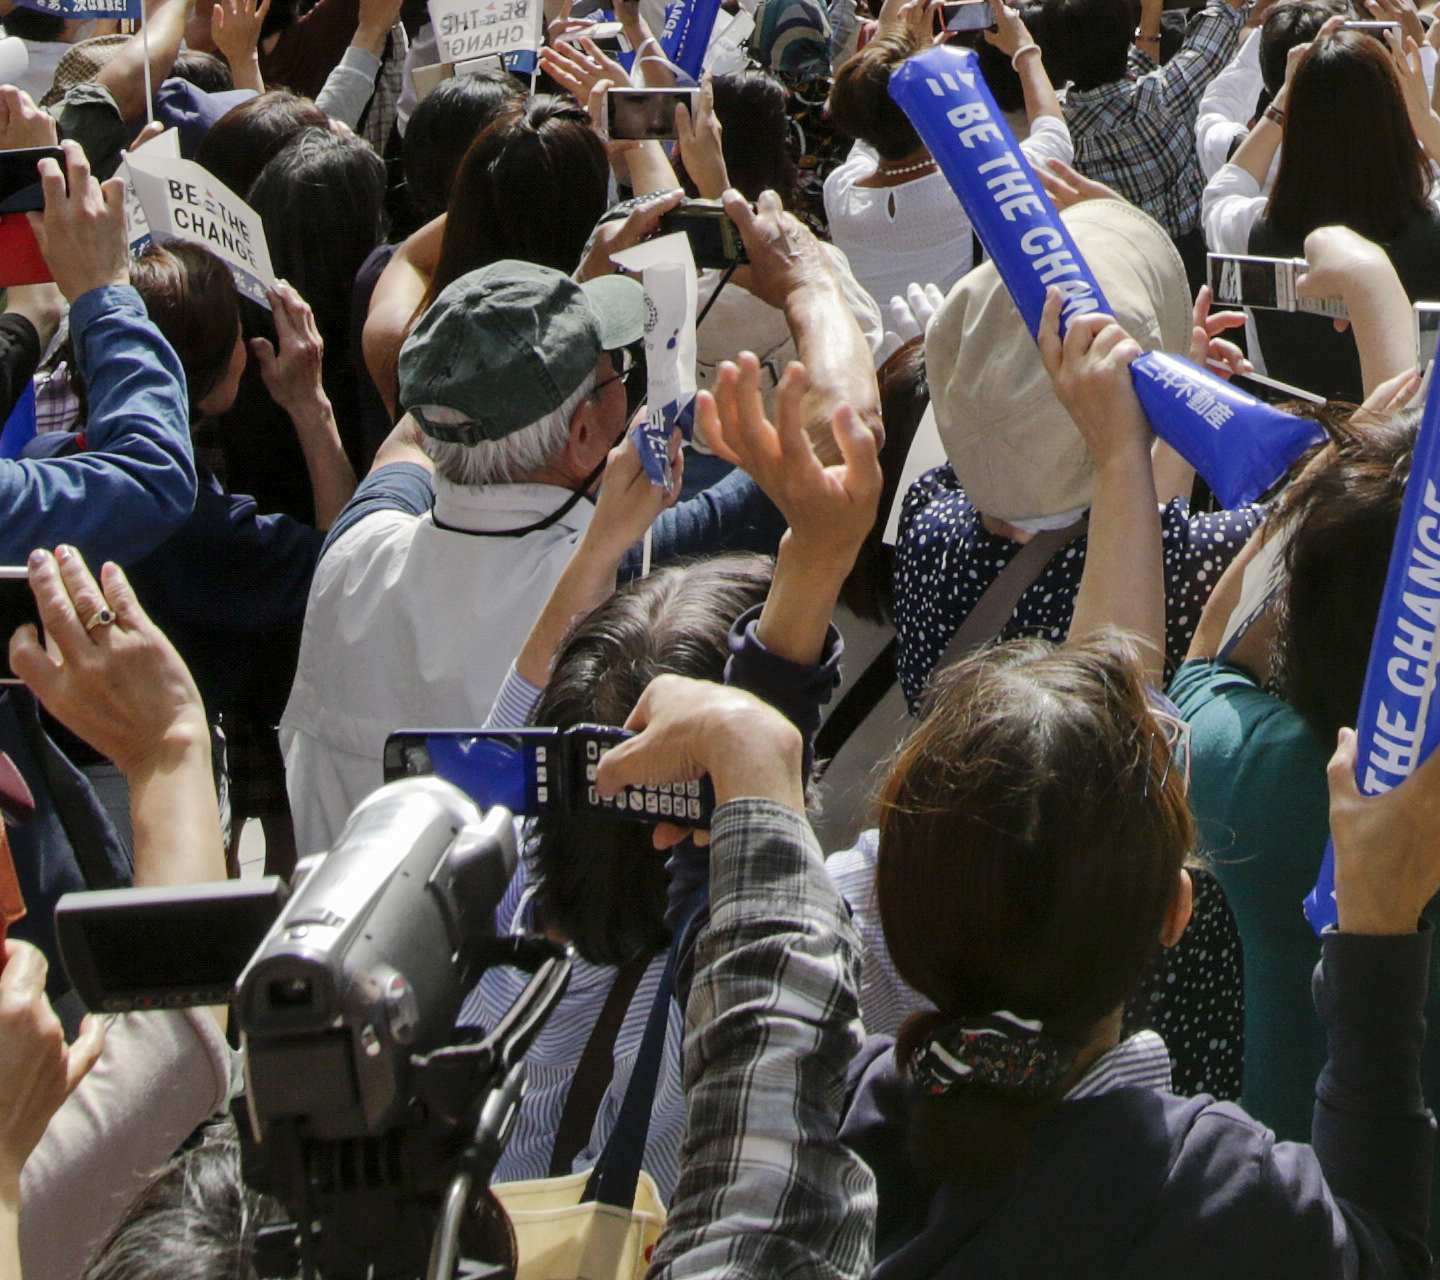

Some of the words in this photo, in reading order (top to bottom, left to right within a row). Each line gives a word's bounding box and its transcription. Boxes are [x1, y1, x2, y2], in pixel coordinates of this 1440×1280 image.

[947, 101, 1005, 148] BE
[977, 151, 1046, 222] THE
[168, 179, 198, 205] BE
[218, 202, 251, 244] THE
[174, 207, 258, 269] CHANGE
[1132, 353, 1235, 431] 三井不動産
[1364, 700, 1424, 794] THE
